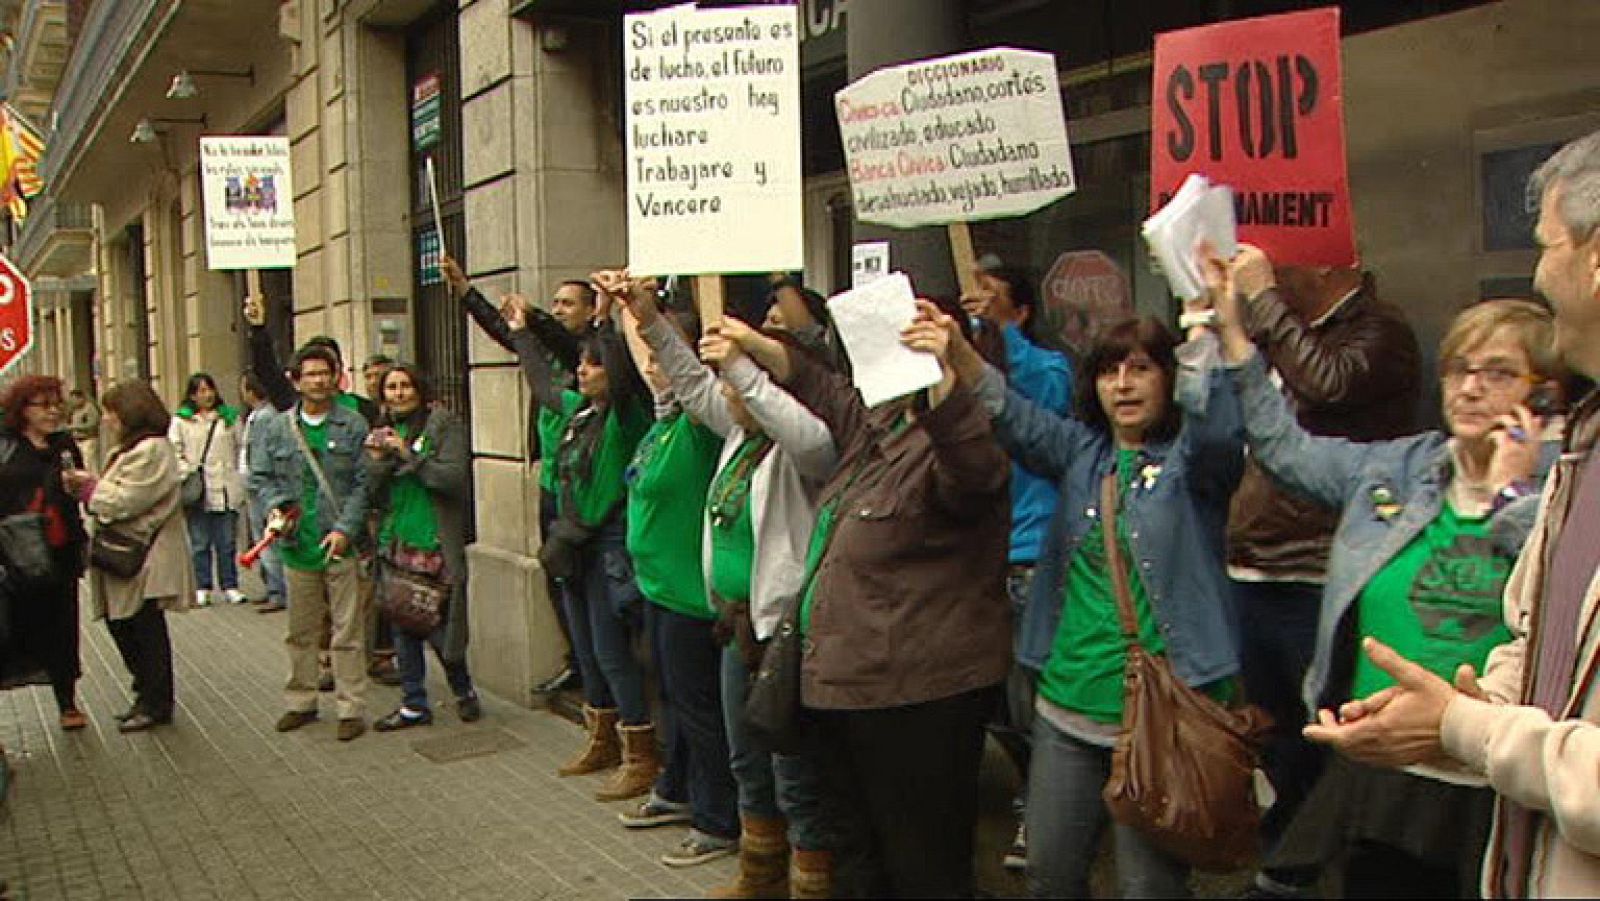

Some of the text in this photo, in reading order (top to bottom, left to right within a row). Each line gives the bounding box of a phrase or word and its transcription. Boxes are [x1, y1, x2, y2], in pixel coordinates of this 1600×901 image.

[632, 17, 793, 53] Si el presente es
[631, 56, 651, 81] de
[712, 51, 728, 77] el
[907, 55, 1005, 85] DICCIONARIO
[632, 99, 656, 115] es
[660, 85, 728, 112] nuestro
[1166, 54, 1319, 163] STOP
[923, 108, 996, 141] educado
[754, 161, 768, 186] y
[851, 158, 898, 184] Banca
[949, 138, 1040, 170] Ciudadano
